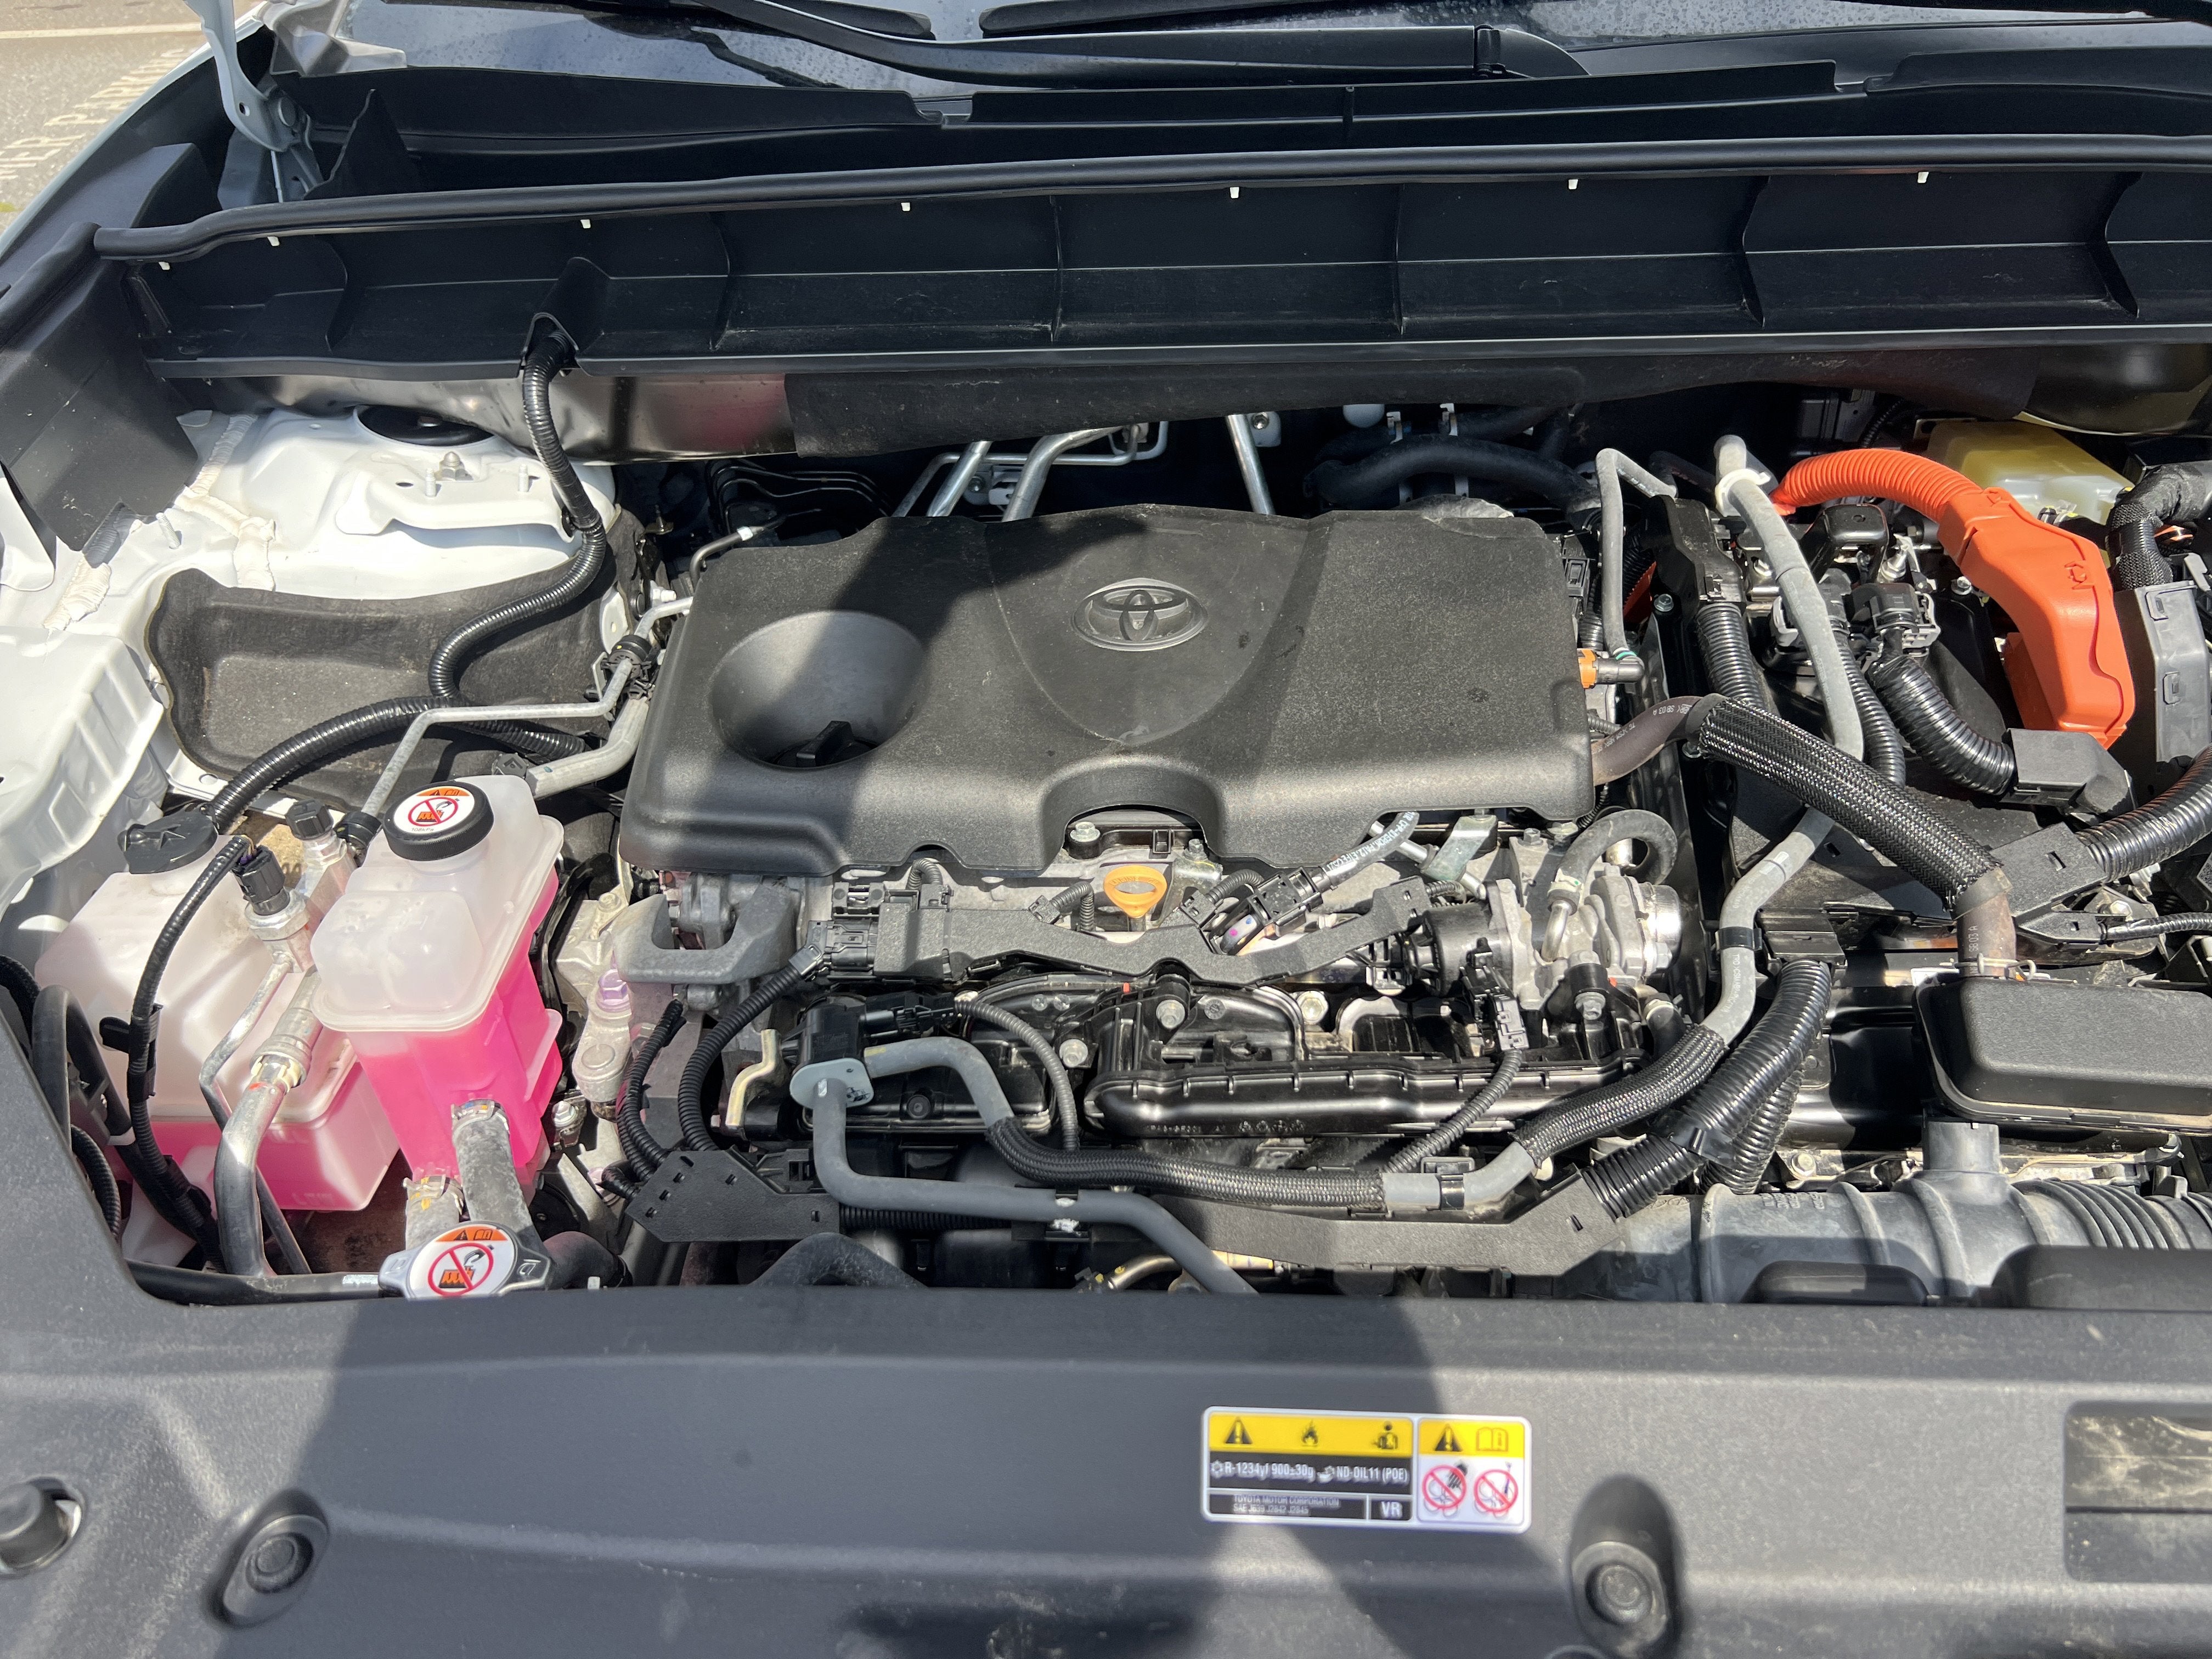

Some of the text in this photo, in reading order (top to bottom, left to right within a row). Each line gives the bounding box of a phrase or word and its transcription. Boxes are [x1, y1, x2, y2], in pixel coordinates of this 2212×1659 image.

[1968, 933, 1979, 952] SB03
[1224, 1461, 1269, 1477] R-1234yf
[1271, 1463, 1314, 1479] 900±30g
[1382, 1467, 1408, 1482] (POE)
[1233, 1503, 1247, 1511] SAE
[1234, 1494, 1340, 1506] TOYOTA MOTOR CORPORATION
[1381, 1501, 1400, 1516] VR
